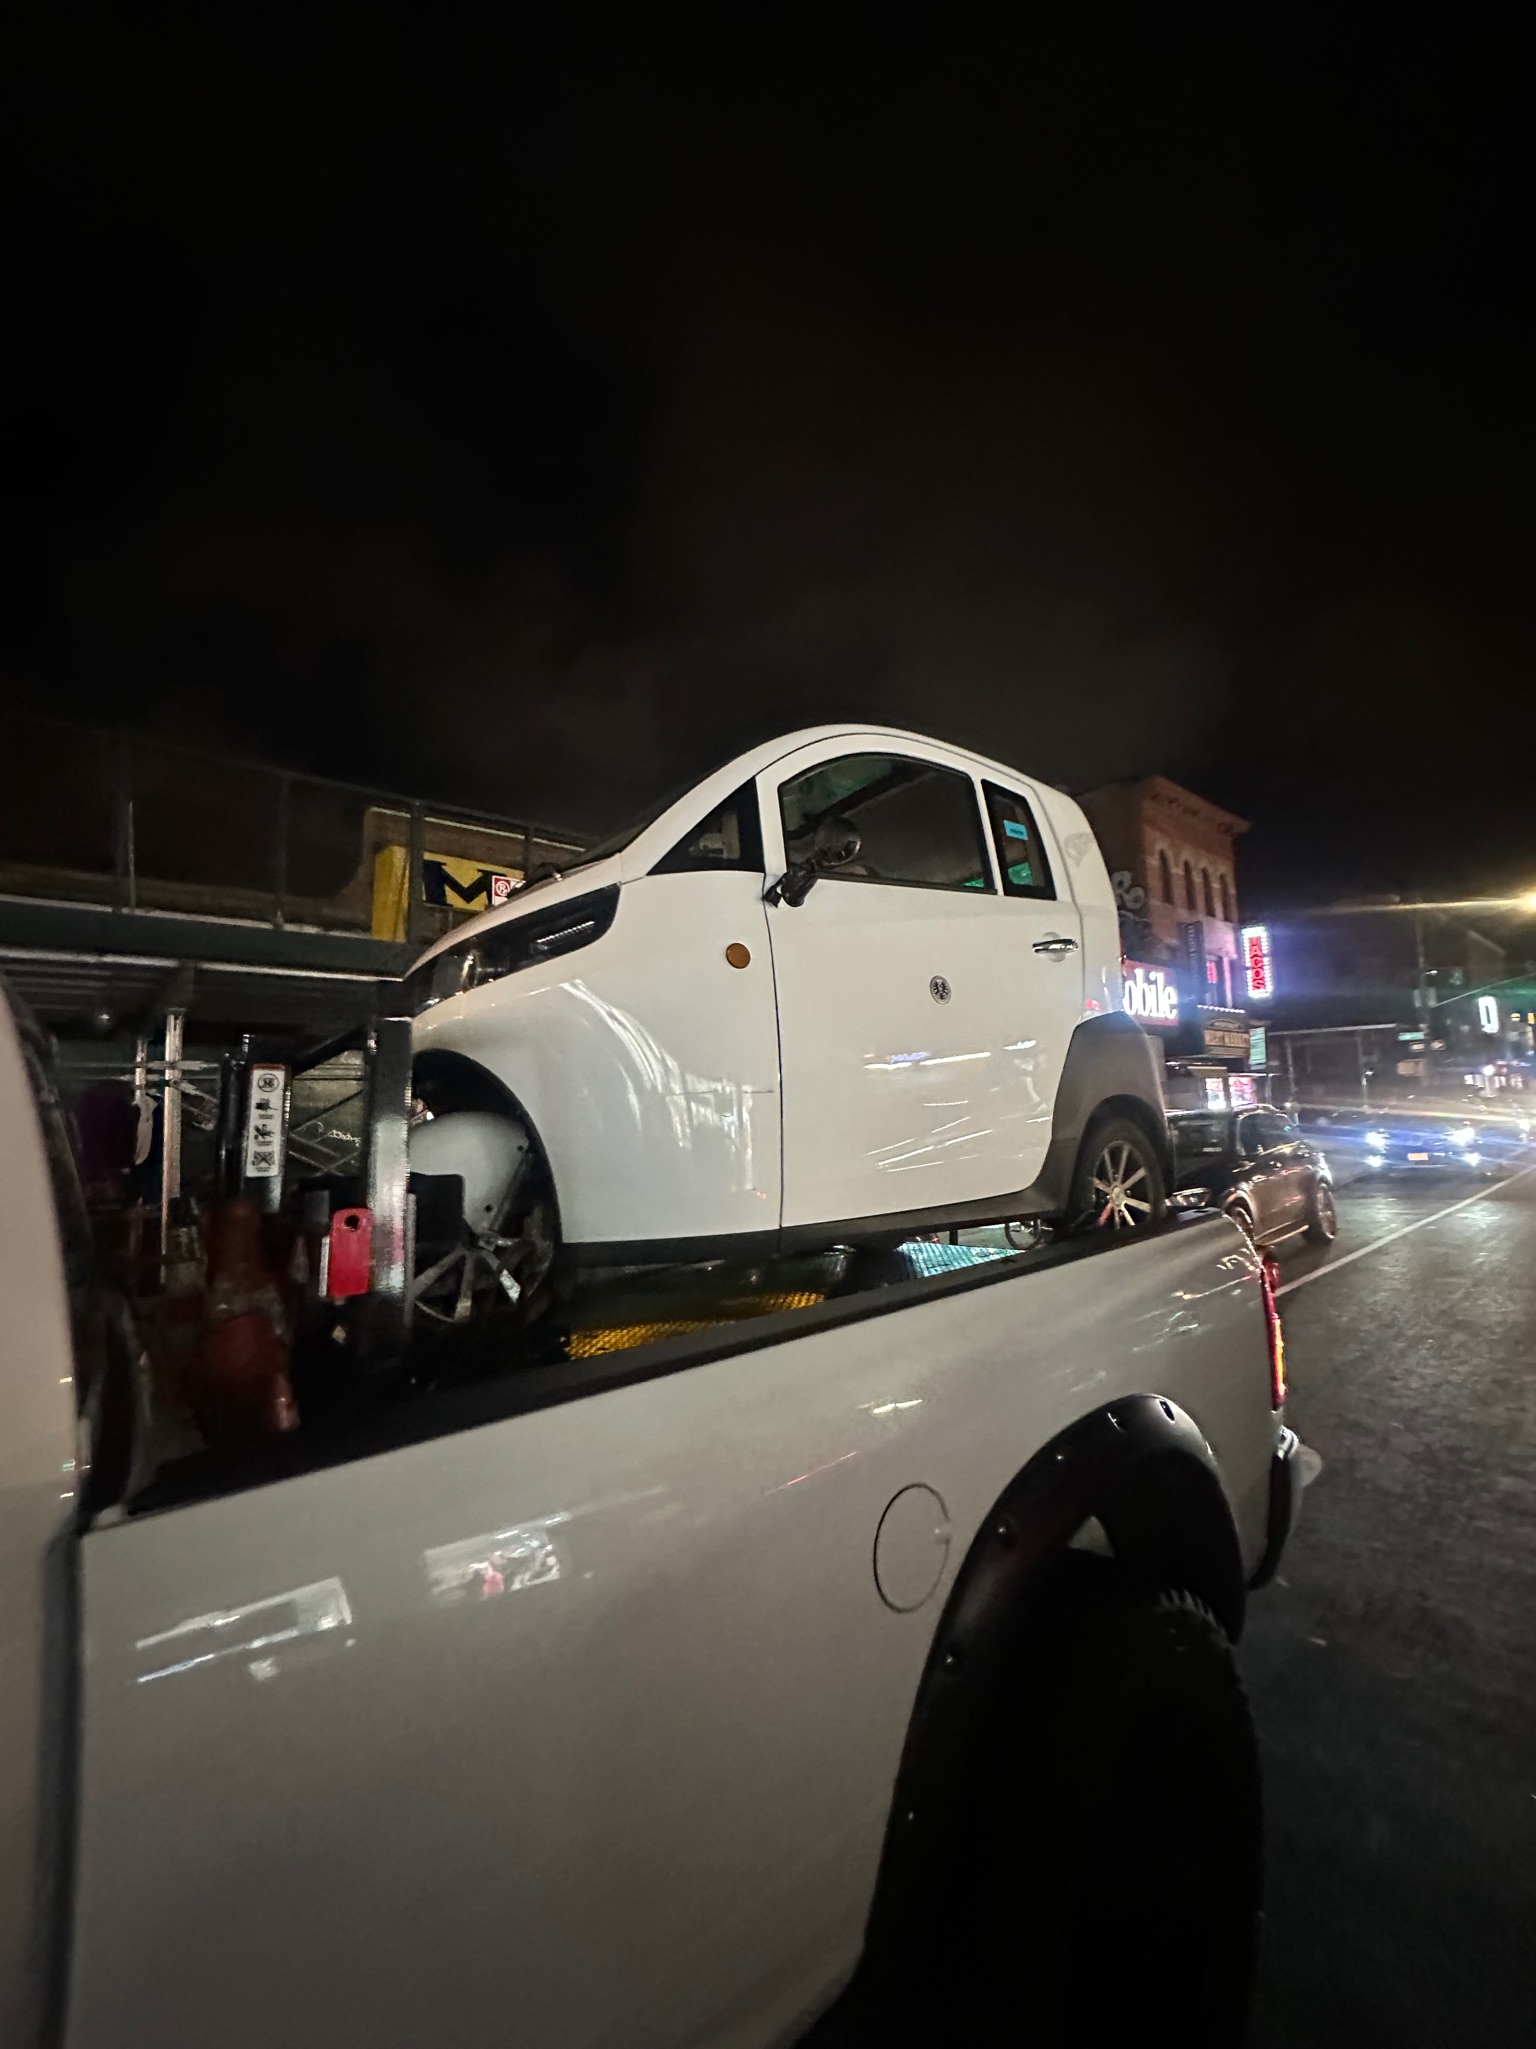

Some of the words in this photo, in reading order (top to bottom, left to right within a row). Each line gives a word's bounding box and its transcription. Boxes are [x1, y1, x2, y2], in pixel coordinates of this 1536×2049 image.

[423, 859, 507, 907] M
[1249, 936, 1266, 991] TACOS
[1122, 967, 1178, 1019] obile
